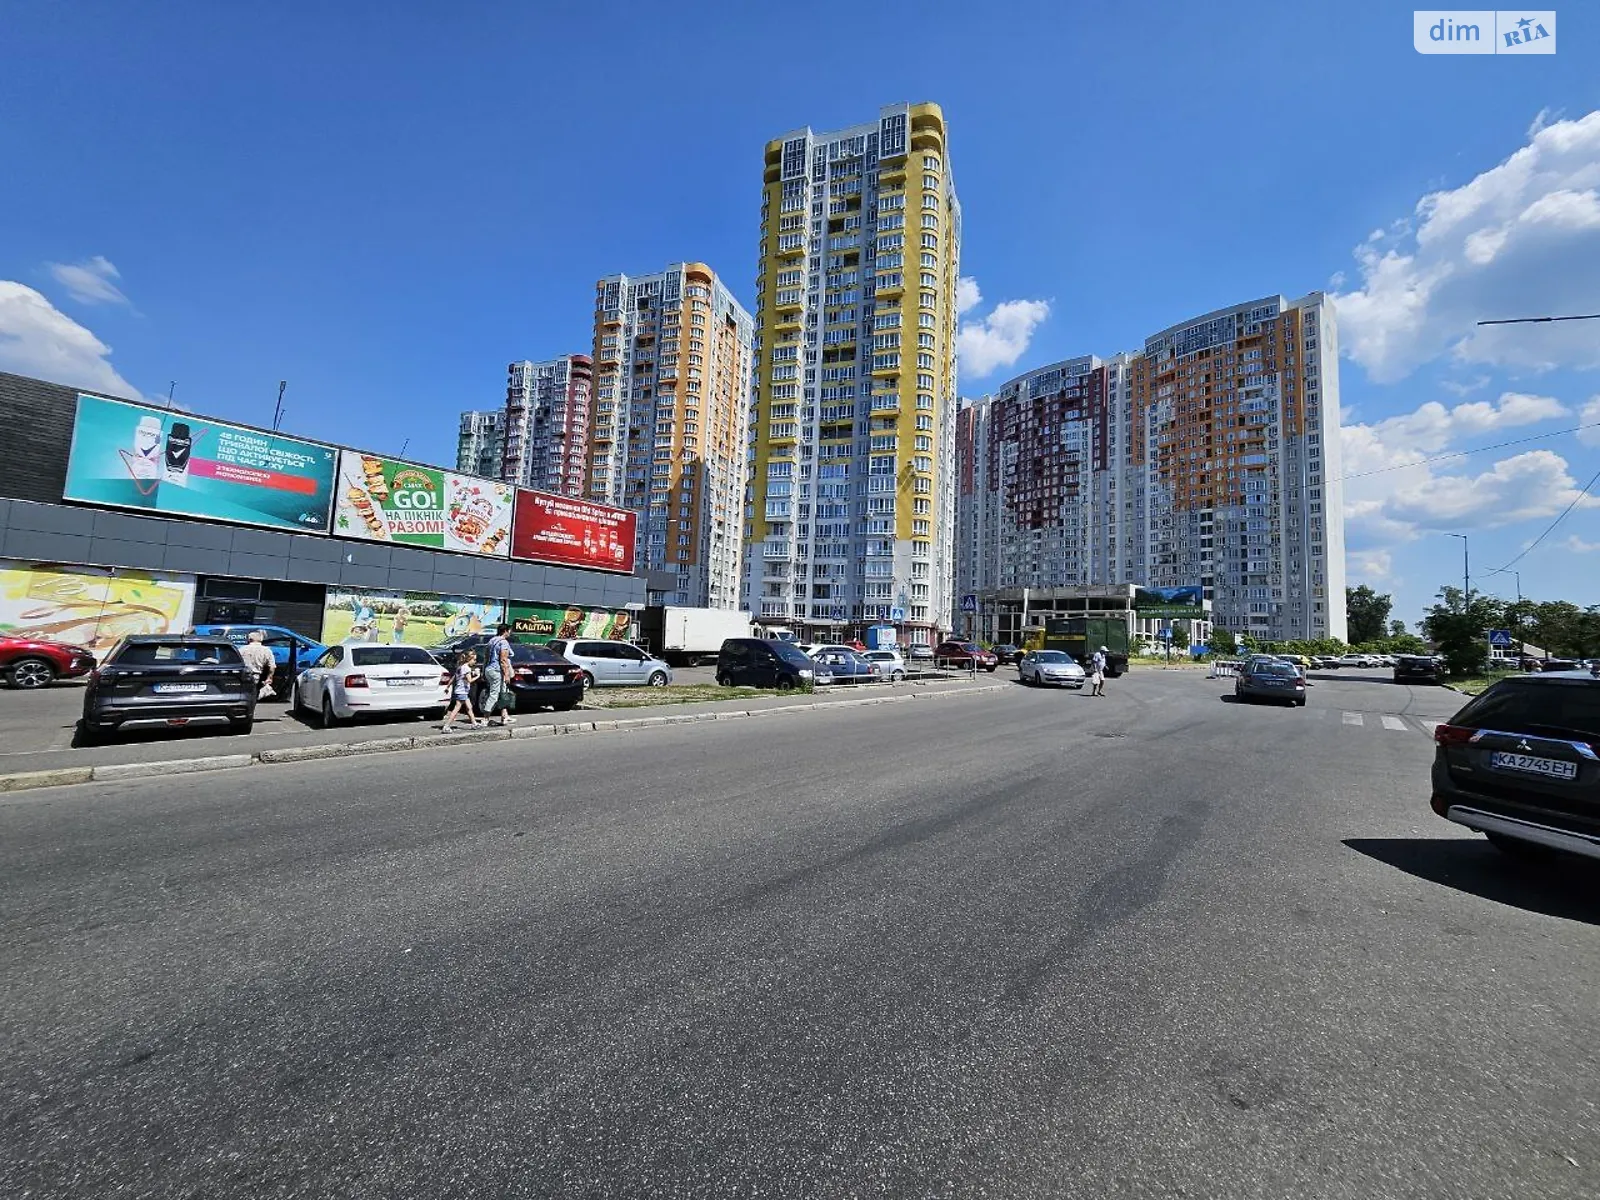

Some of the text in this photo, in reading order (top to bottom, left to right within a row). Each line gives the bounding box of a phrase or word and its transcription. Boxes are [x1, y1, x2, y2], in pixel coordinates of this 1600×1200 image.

[219, 432, 268, 447] 48 ГОДИН
[216, 453, 236, 462] ПІД
[237, 456, 258, 466] ЧАС
[218, 446, 305, 468] ЩО АКТИВУЄТЬСЯ
[393, 490, 437, 509] GO!
[534, 496, 554, 509] Купуй
[385, 510, 444, 521] НА ПІКНІК
[388, 520, 444, 533] РАЗОМ!
[515, 621, 553, 632] КАШТАН
[1498, 753, 1575, 776] KA 2745 EH
